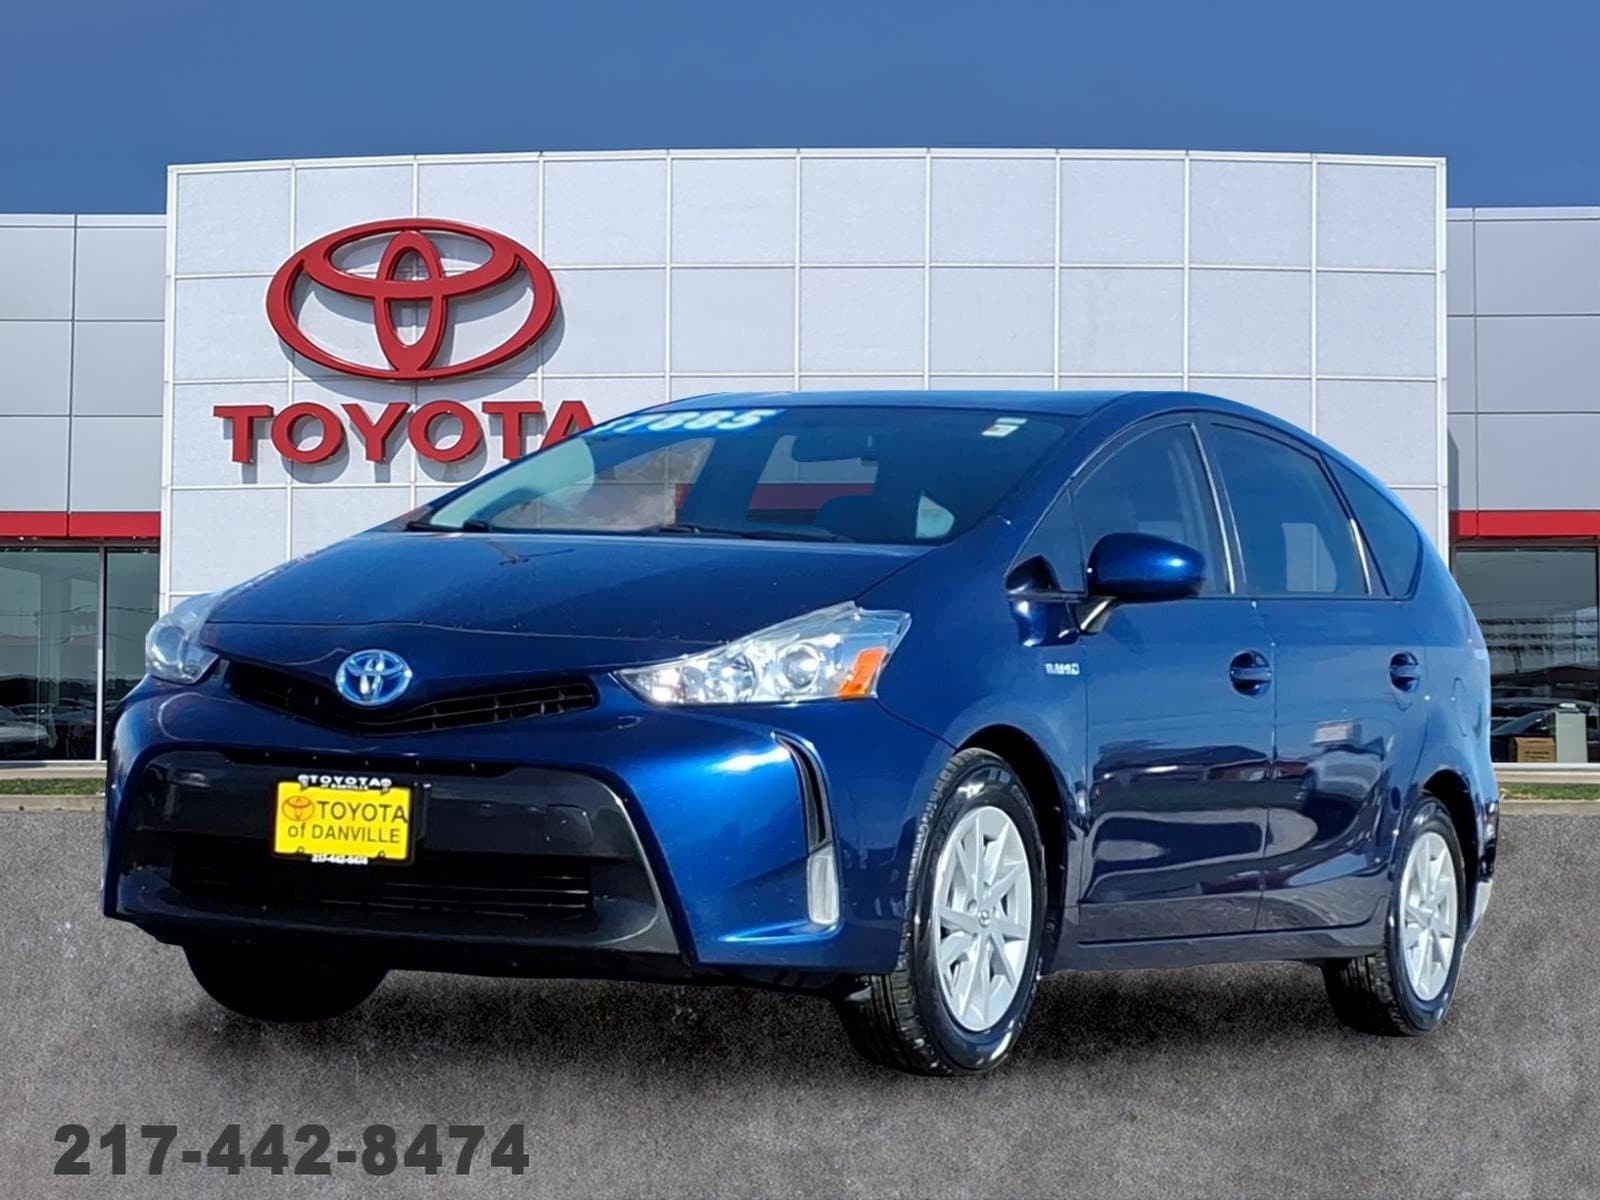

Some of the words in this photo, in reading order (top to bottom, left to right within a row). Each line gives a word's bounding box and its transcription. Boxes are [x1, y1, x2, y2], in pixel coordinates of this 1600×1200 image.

[213, 400, 595, 464] TOYOTA
[308, 774, 382, 787] TOYOTA
[316, 800, 409, 824] TOYOTA
[287, 822, 307, 838] of
[311, 824, 401, 844] DANVILLE
